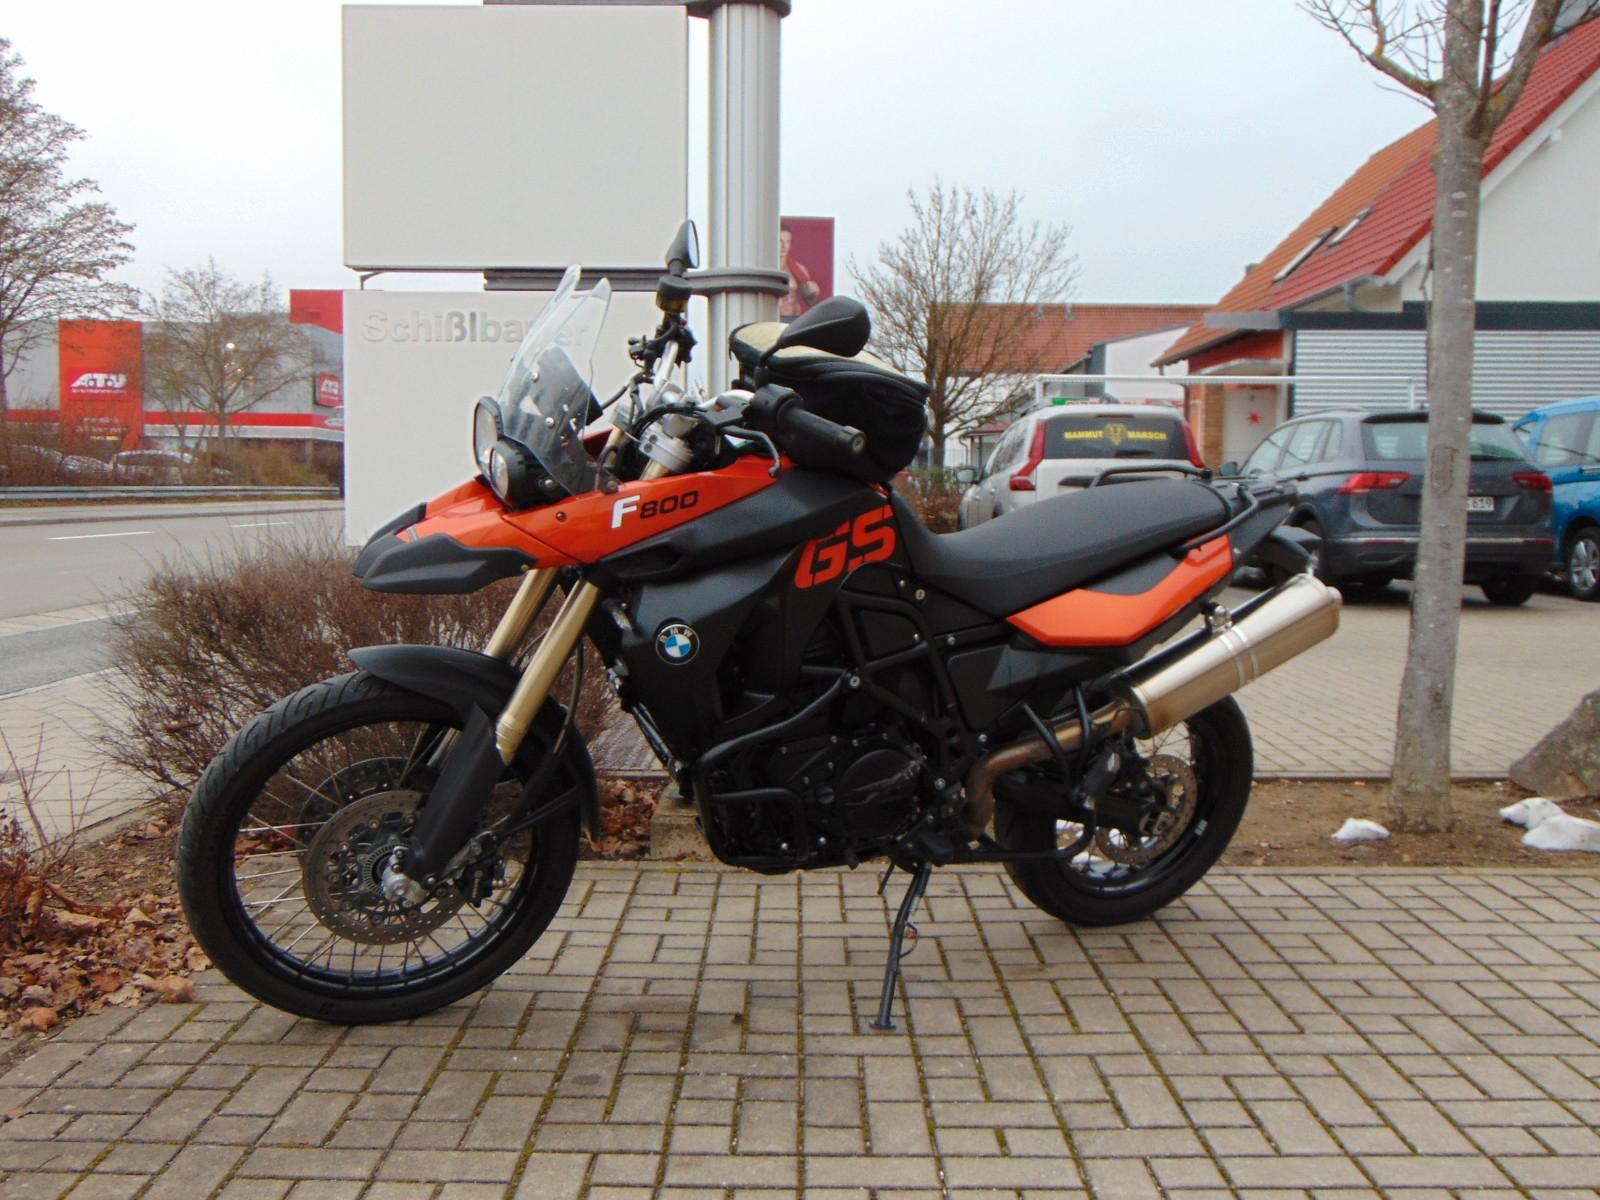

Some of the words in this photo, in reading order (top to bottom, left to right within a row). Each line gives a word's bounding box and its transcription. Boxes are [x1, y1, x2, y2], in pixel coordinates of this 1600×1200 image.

[361, 310, 588, 347] Schißlbaer
[1064, 430, 1105, 439] MAMMUT
[1127, 430, 1168, 441] MARSCH
[794, 504, 897, 590] GS
[659, 626, 694, 644] BMW
